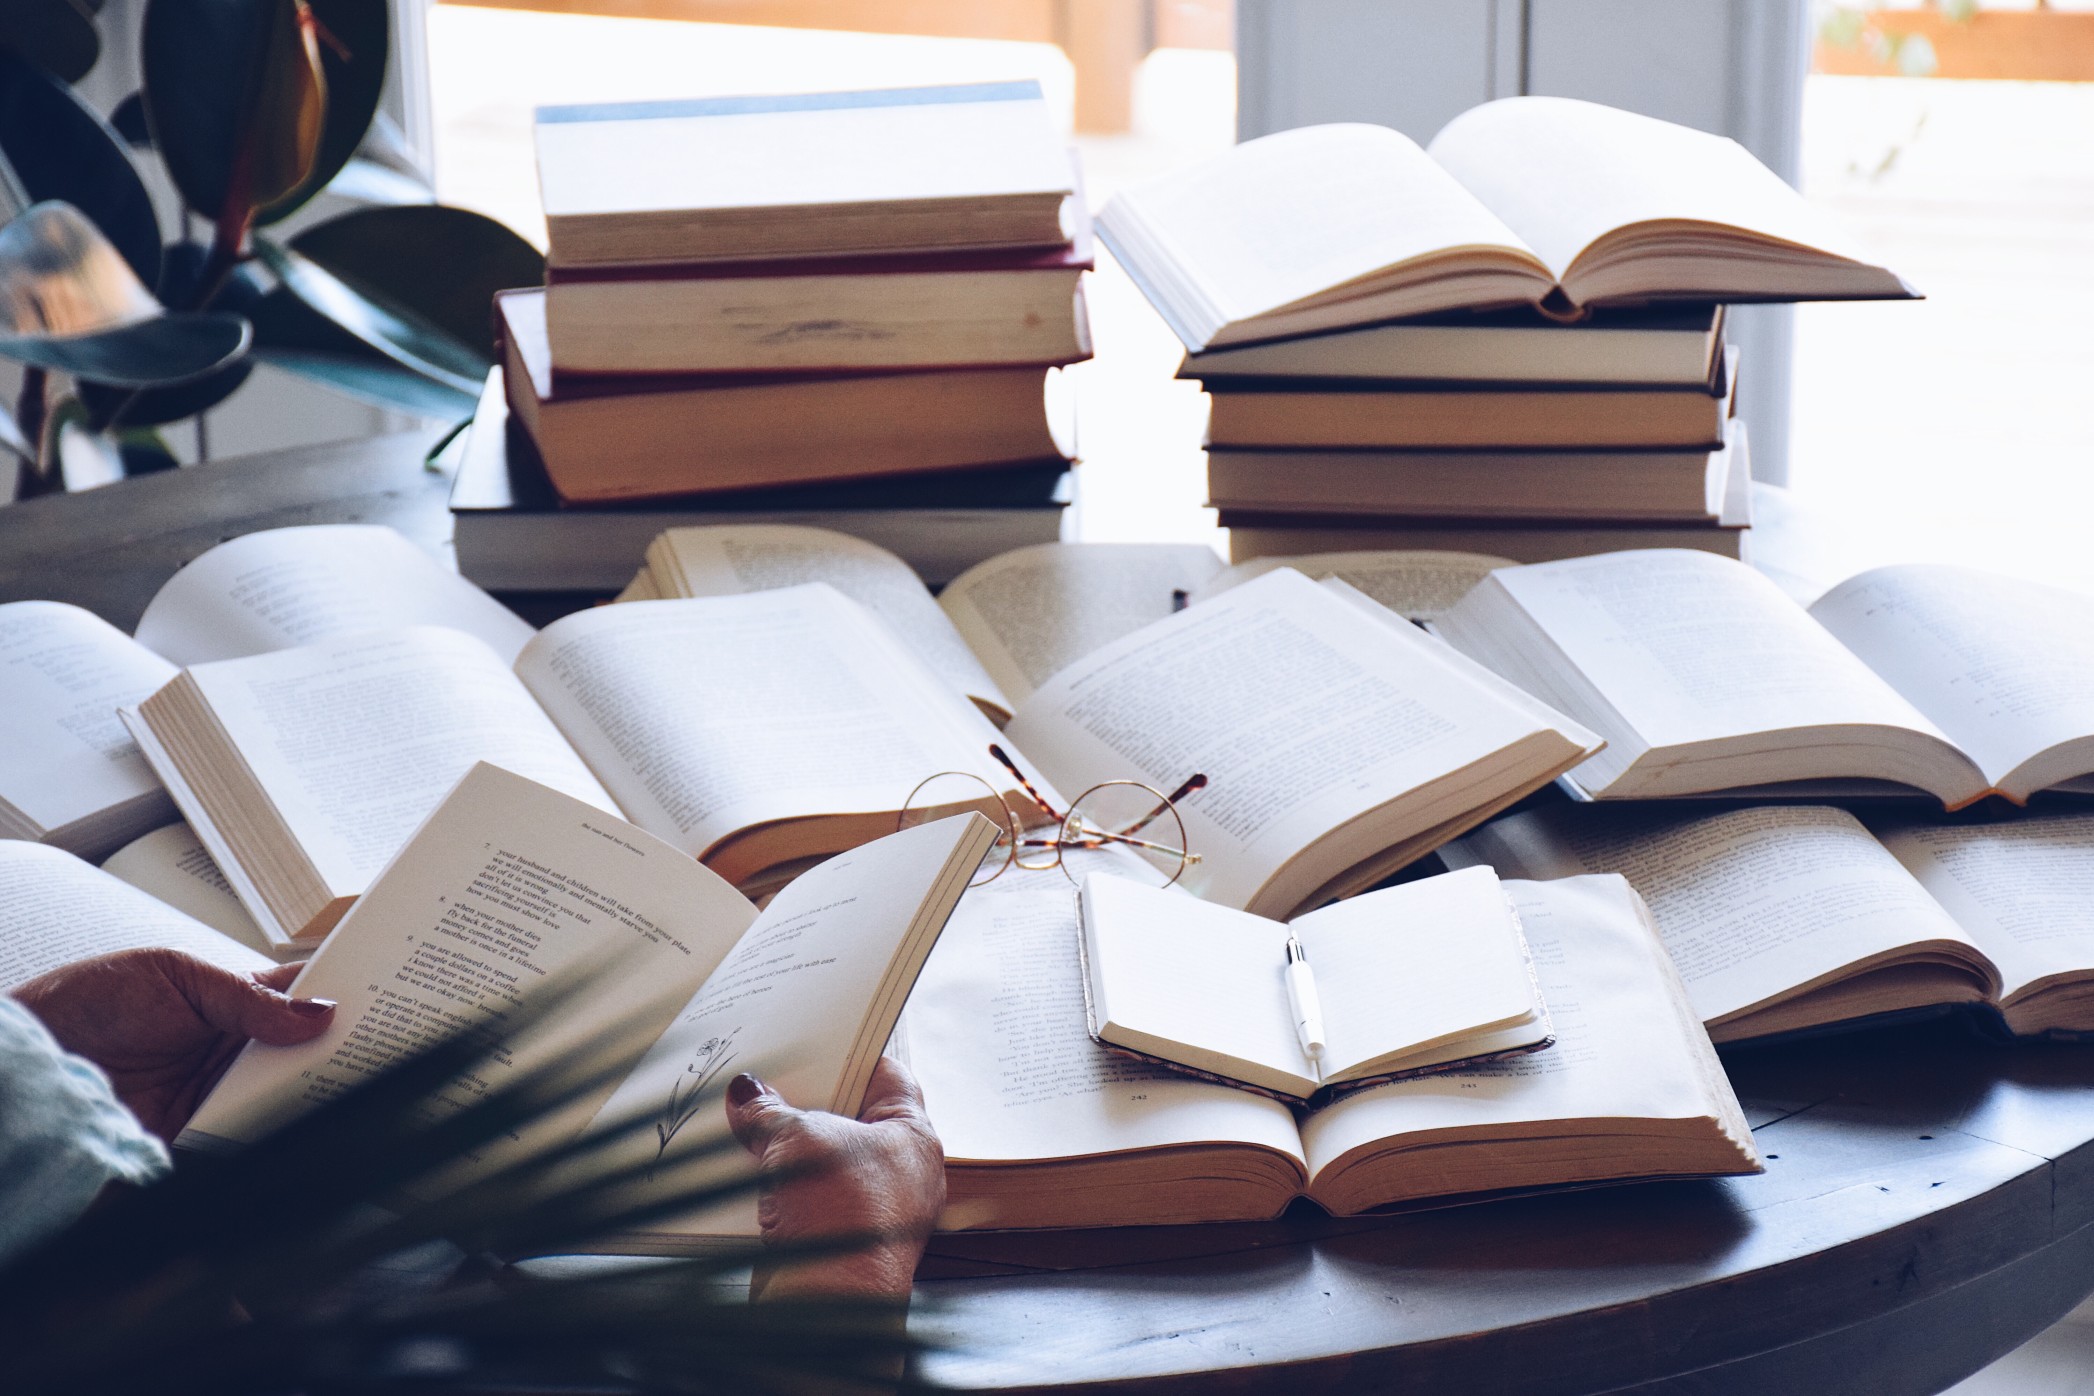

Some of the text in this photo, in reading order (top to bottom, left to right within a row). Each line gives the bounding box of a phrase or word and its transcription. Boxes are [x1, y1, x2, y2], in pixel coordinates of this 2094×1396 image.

[581, 821, 590, 829] the
[623, 842, 644, 856] flowers
[472, 879, 514, 900] sacrificing
[514, 896, 549, 913] yourself
[478, 870, 500, 882] don't
[500, 877, 511, 887] let
[522, 889, 559, 908] convince
[558, 906, 574, 915] you
[574, 912, 591, 923] that
[484, 864, 497, 872] all
[523, 879, 548, 894] wrong
[465, 885, 560, 929] how you must show love
[496, 849, 516, 859] your
[517, 855, 551, 873] husband
[550, 870, 567, 880] and
[566, 878, 599, 896] children
[599, 894, 617, 905] will
[617, 902, 634, 915] take
[635, 912, 654, 927] from
[653, 926, 672, 939] your
[671, 938, 691, 954] plate
[505, 862, 522, 871] will
[522, 868, 567, 894] emotionally
[568, 890, 585, 900] and
[584, 897, 618, 917] mentally
[619, 914, 643, 931] starve
[643, 930, 659, 942] you
[440, 917, 529, 956] money comes and goes
[447, 908, 537, 949] fly back for the funeral
[453, 902, 474, 913] when
[474, 910, 495, 921] your
[495, 918, 524, 932] mother
[524, 928, 541, 941] dies
[420, 941, 436, 950] you
[437, 947, 450, 955] are
[451, 952, 483, 967] allowed
[492, 968, 518, 982] spend
[440, 928, 469, 941] mother
[478, 942, 497, 953] once
[515, 955, 546, 974] lifetime
[395, 971, 408, 981] but
[422, 982, 435, 990] are
[436, 987, 456, 999] okay
[412, 957, 434, 969] know
[436, 966, 457, 978] there
[458, 975, 474, 984] was
[481, 983, 500, 995] time
[415, 969, 437, 980] could
[437, 977, 452, 985] not
[452, 983, 478, 996] afford
[421, 951, 447, 964] couple
[448, 959, 475, 975] dollars
[495, 980, 520, 994] coffee
[380, 990, 396, 998] you
[397, 995, 418, 1005] can't
[418, 1002, 441, 1013] speak
[442, 1010, 473, 1025] english
[382, 1008, 395, 1018] did
[396, 1013, 412, 1023] that
[385, 1001, 414, 1014] operate
[422, 1014, 459, 1030] computer
[349, 1029, 402, 1051] flashy phones
[355, 1023, 408, 1043] other mothers
[361, 1014, 377, 1023] you
[392, 1024, 406, 1032] not
[407, 1029, 422, 1039] any
[326, 1058, 364, 1071] you have
[335, 1049, 382, 1066] and worked
[354, 1044, 391, 1058] confined
